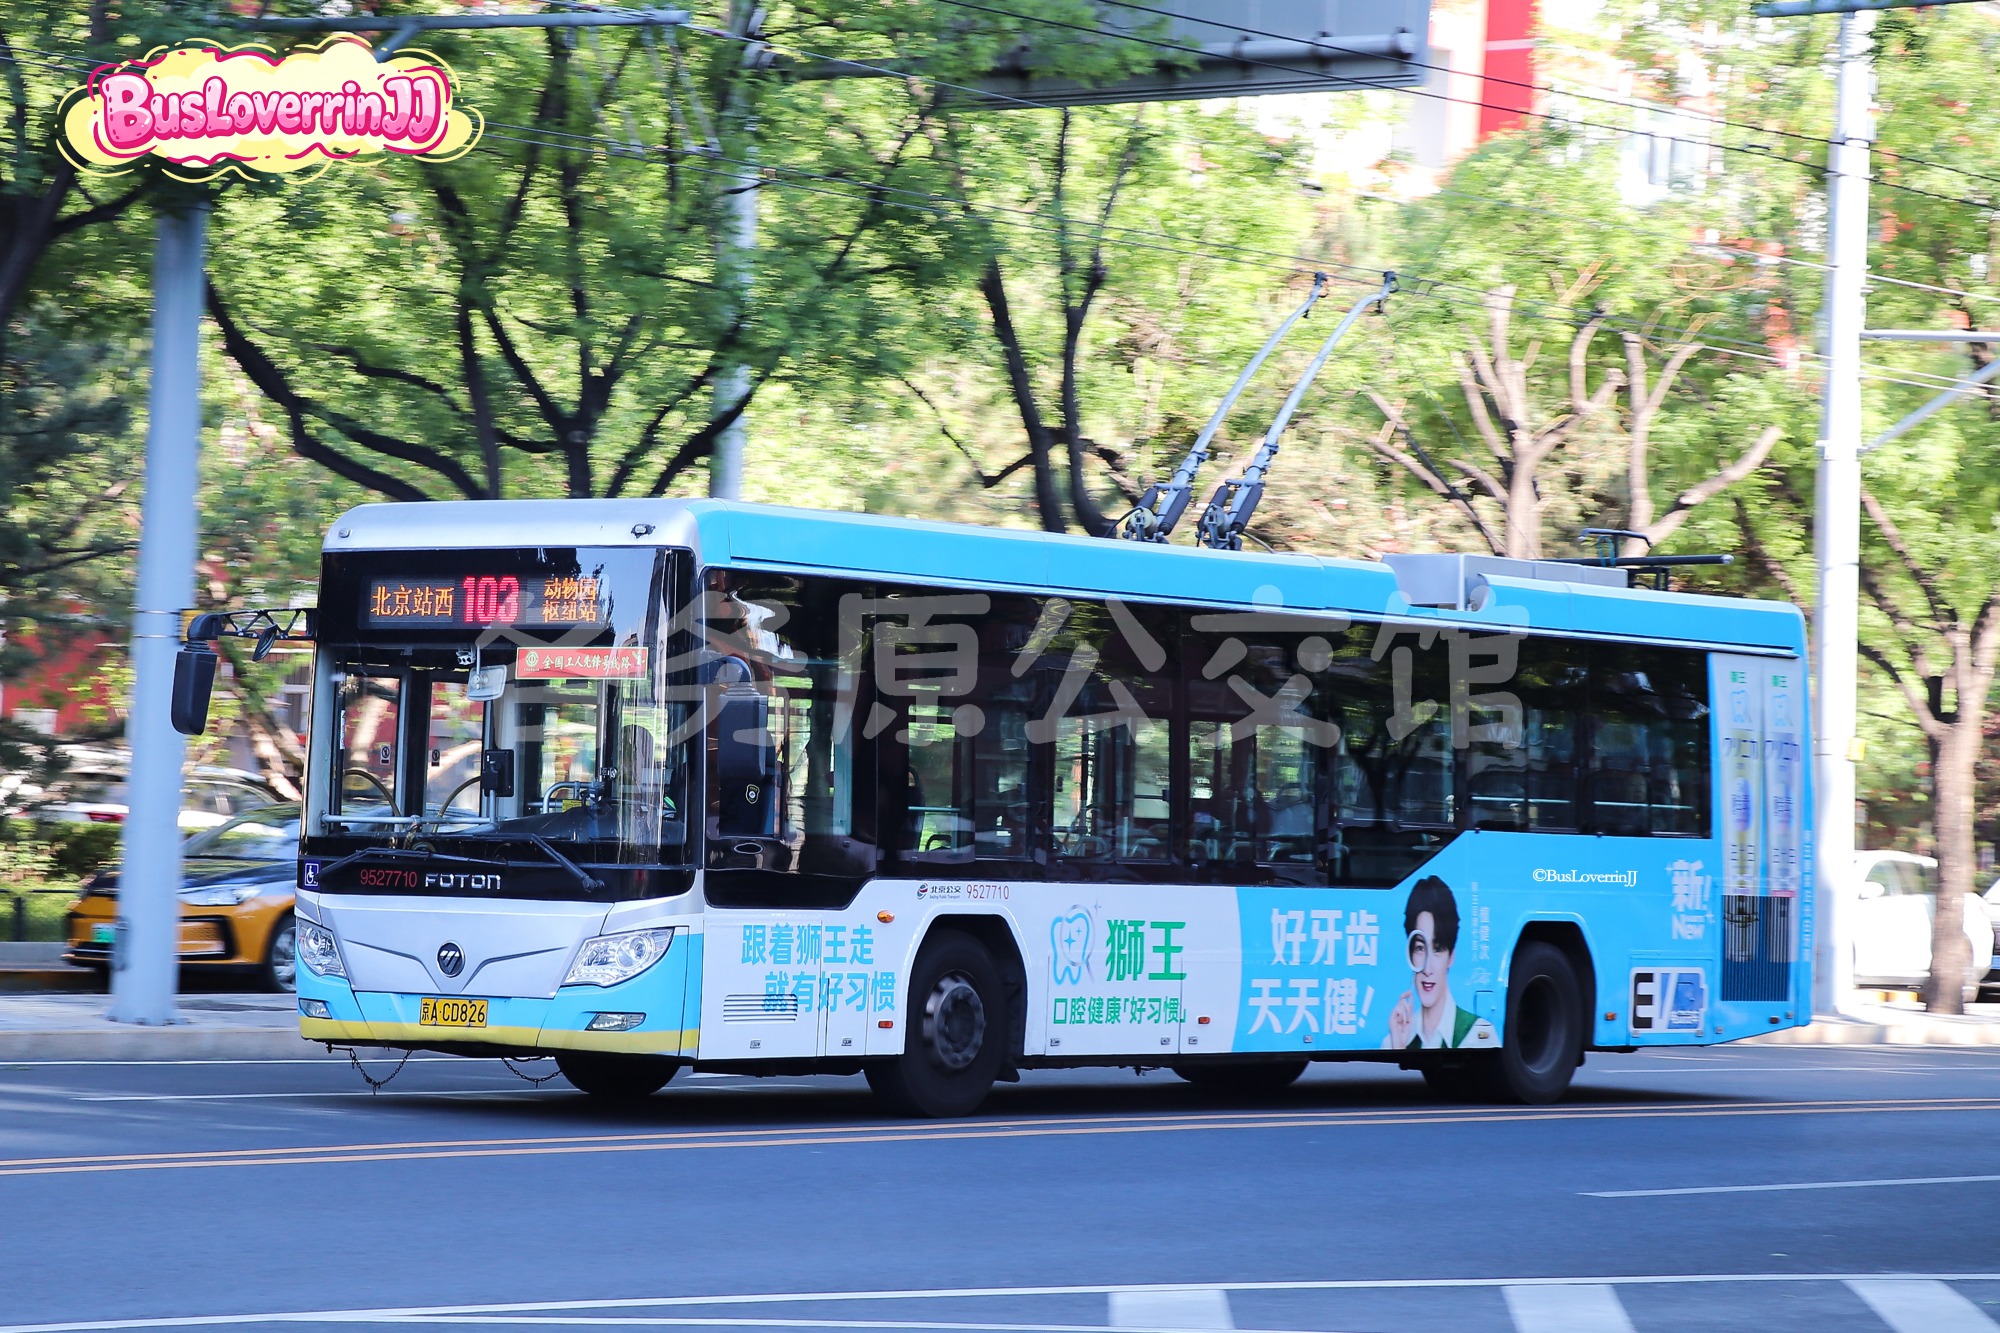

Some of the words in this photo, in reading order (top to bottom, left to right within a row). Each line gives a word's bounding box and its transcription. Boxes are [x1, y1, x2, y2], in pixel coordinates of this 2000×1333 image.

[371, 585, 455, 617] 北京站西
[463, 575, 520, 623] 103
[543, 577, 598, 601] 动物园
[542, 600, 598, 623] 枢纽站
[542, 654, 632, 671] 全国工人先锋号线路
[360, 869, 418, 888] 9527710
[425, 873, 501, 890] FOTON
[930, 885, 962, 894] 北京公交
[966, 884, 1010, 900] 9527710
[741, 922, 874, 966] 跟着狮王走
[1271, 908, 1380, 967] 好牙齿
[1106, 919, 1187, 982] 獅王
[761, 970, 896, 1014] 就有好习惯
